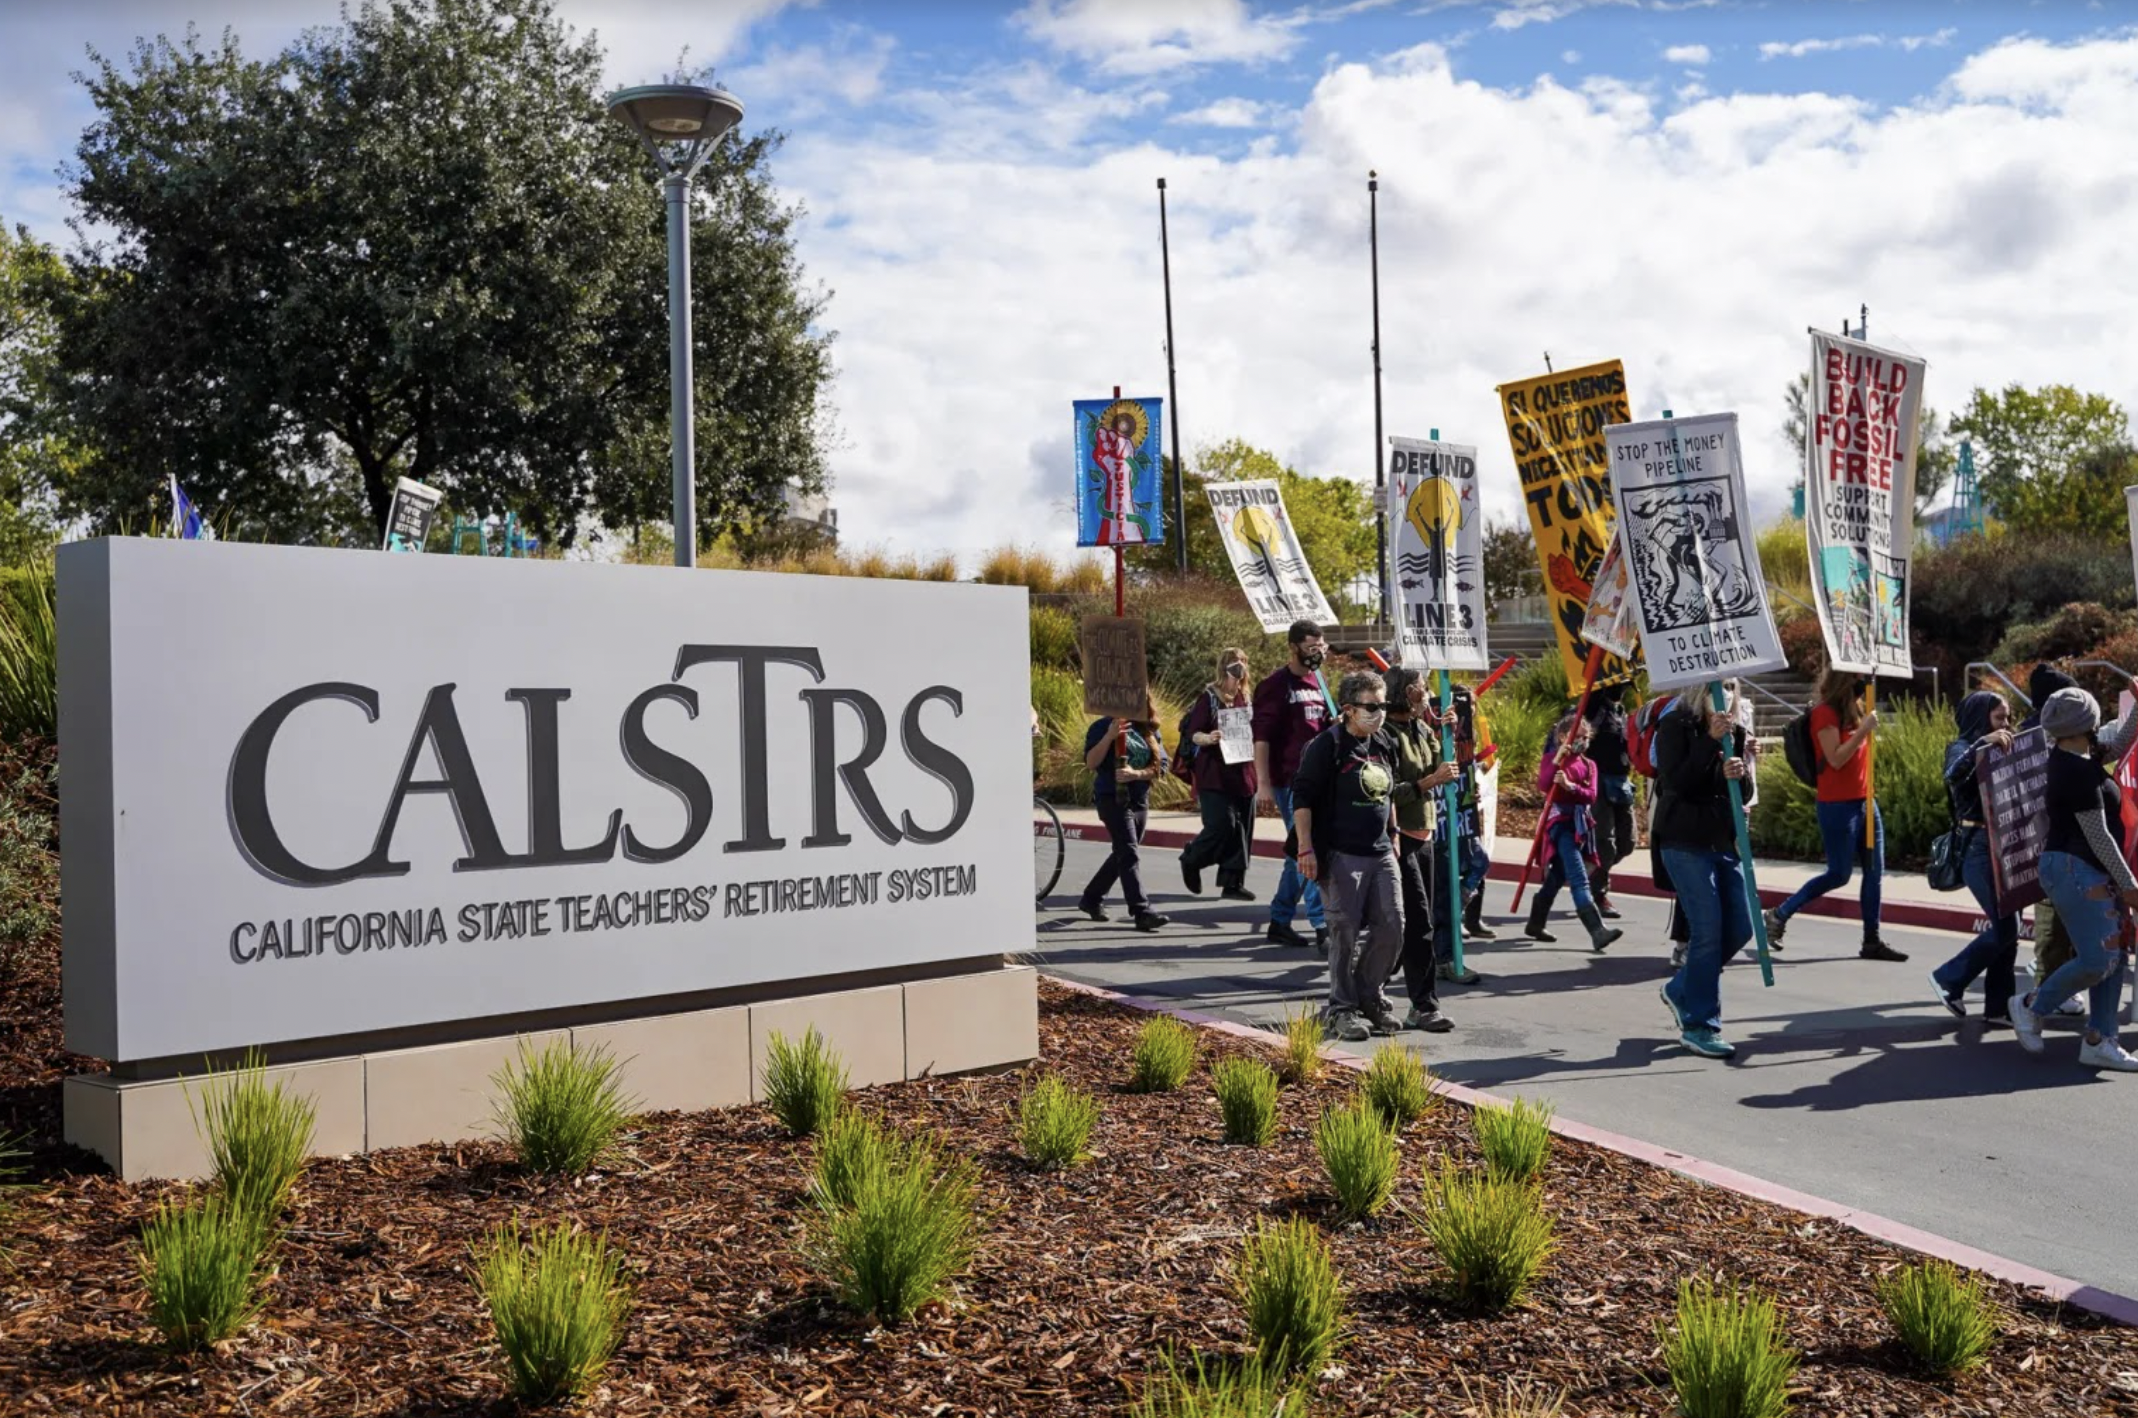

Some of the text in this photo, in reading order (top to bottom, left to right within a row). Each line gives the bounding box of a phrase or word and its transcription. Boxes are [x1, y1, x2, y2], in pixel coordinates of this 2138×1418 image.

[1826, 347, 1908, 395] BUILD
[1508, 369, 1626, 417] SI QUEREMOS
[1828, 382, 1901, 427] BACK
[1511, 399, 1632, 457] SOLUCIONES
[1815, 413, 1904, 462] FOSSIL
[1617, 433, 1725, 461] STOP THE MONEY
[1392, 450, 1475, 479] DEFUND
[1645, 456, 1703, 479] PIPELINE
[1829, 449, 1893, 491] FREE
[1114, 461, 1125, 541] JUSTICIA
[1208, 488, 1281, 507] DEFUND
[1831, 522, 1891, 550] SOLUONS
[1255, 593, 1305, 614] LINE
[1302, 593, 1319, 610] 3
[1403, 603, 1474, 630] LINE 3
[1402, 635, 1479, 648] CLIMATE CRISIS
[1667, 625, 1747, 653] TO CLIMATE
[1669, 643, 1758, 674] DESTRUCTION
[225, 644, 976, 889] CALSTRS
[229, 906, 449, 965] CALIFORNIA
[457, 898, 551, 943] STATE
[723, 871, 883, 919] RETIREMENT
[886, 863, 977, 903] SYSTEM
